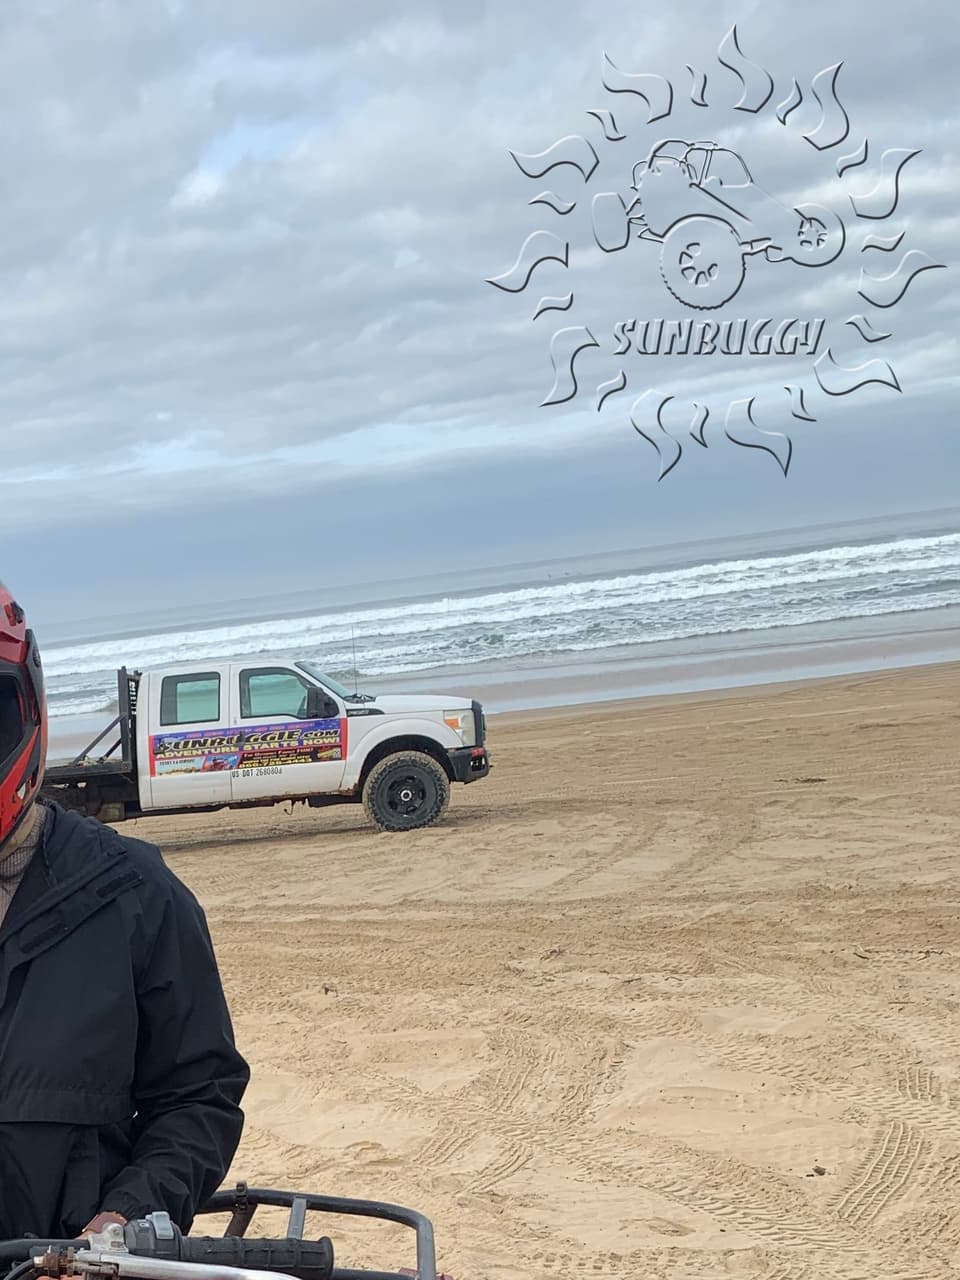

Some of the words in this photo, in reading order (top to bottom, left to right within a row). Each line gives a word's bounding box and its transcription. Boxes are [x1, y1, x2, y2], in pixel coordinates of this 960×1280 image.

[156, 745, 239, 759] ADVENTURE
[243, 741, 298, 751] STARTS
[303, 737, 340, 745] NOW!
[242, 769, 254, 777] DOT
